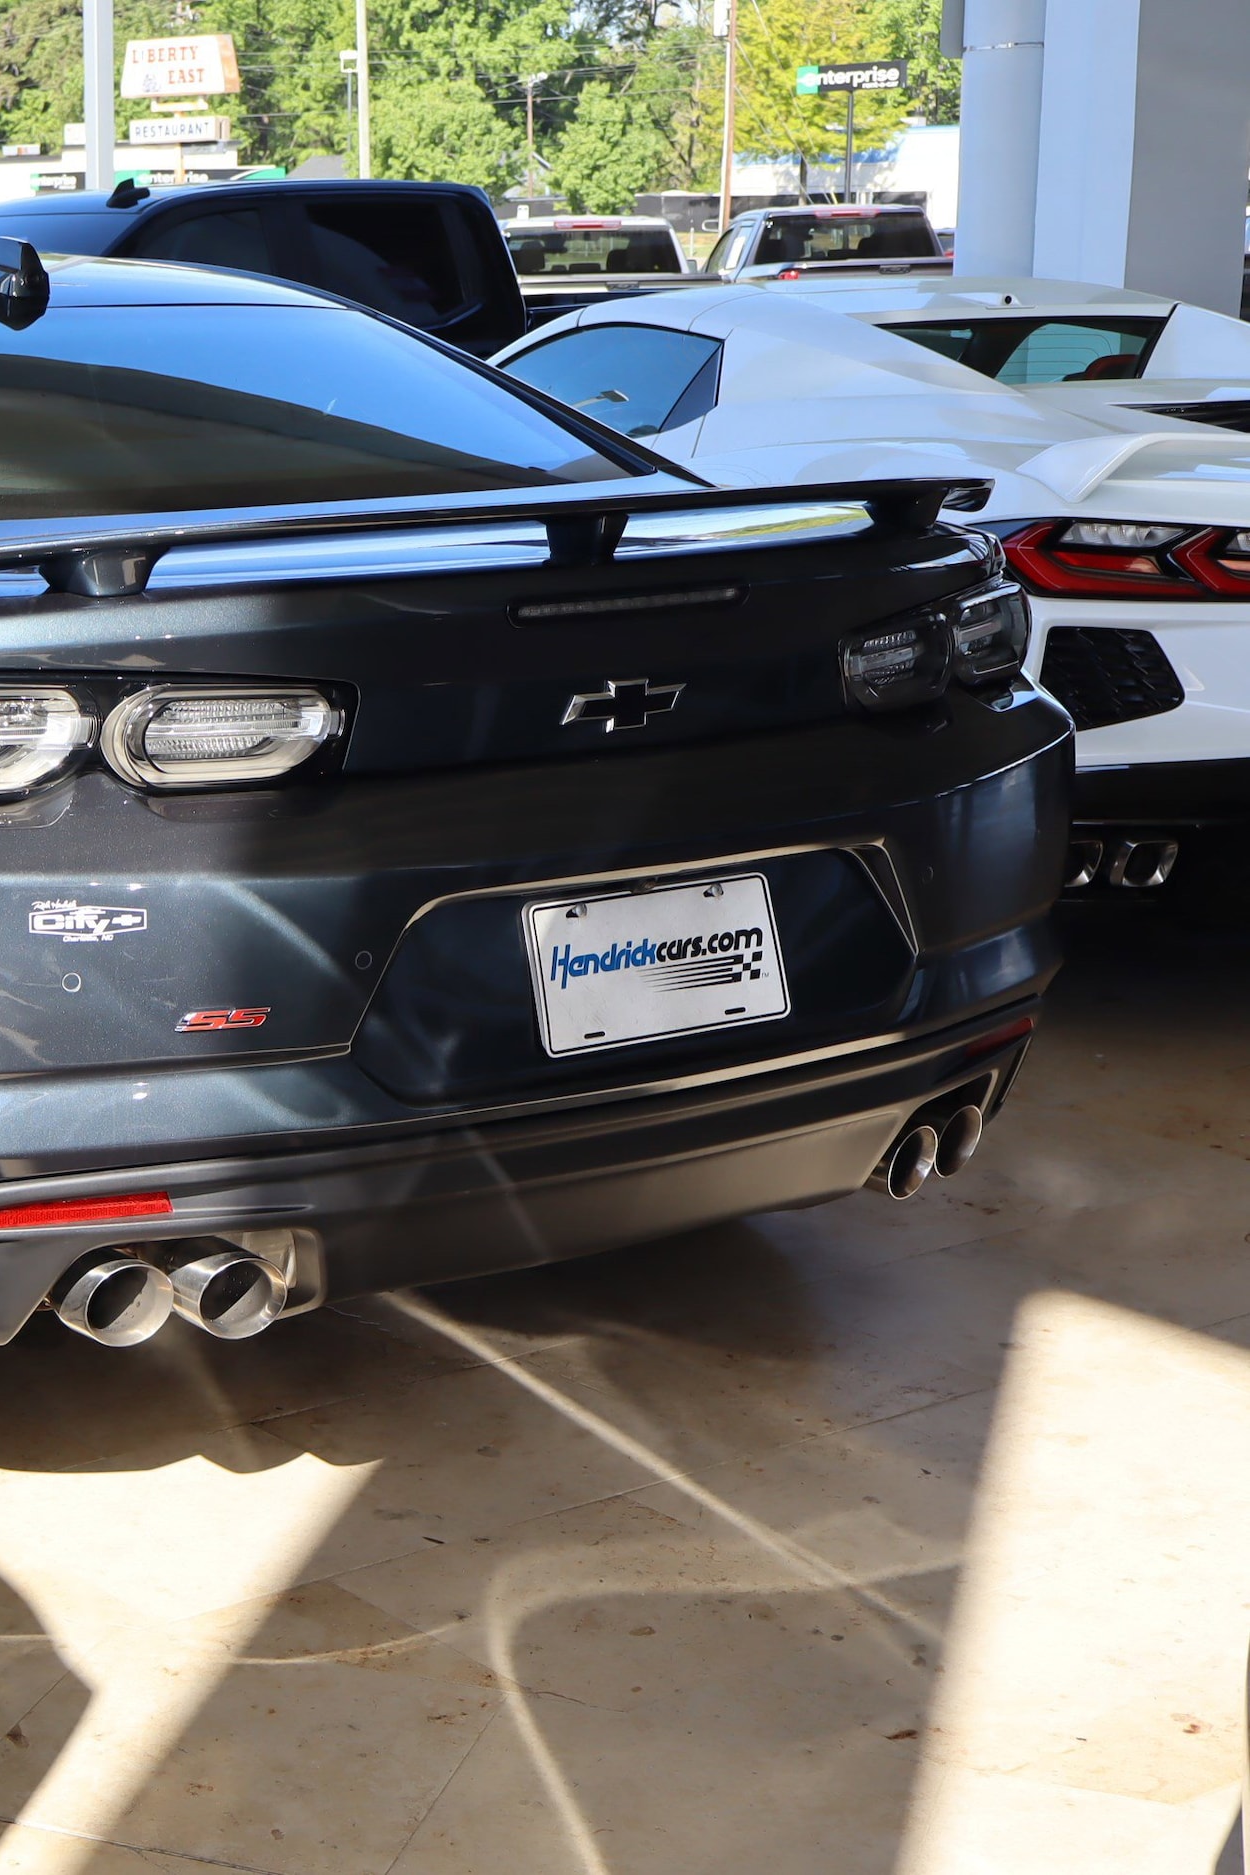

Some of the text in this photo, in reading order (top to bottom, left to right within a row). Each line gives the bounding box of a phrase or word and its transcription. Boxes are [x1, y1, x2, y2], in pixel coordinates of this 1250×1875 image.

[132, 46, 199, 64] LIBERTY
[168, 68, 205, 84] EAST
[803, 65, 900, 88] enterprise
[135, 122, 209, 138] RESTAURANT
[137, 171, 209, 184] enterrise
[551, 927, 763, 990] Hendrickcars.com
[174, 1007, 272, 1032] SS
